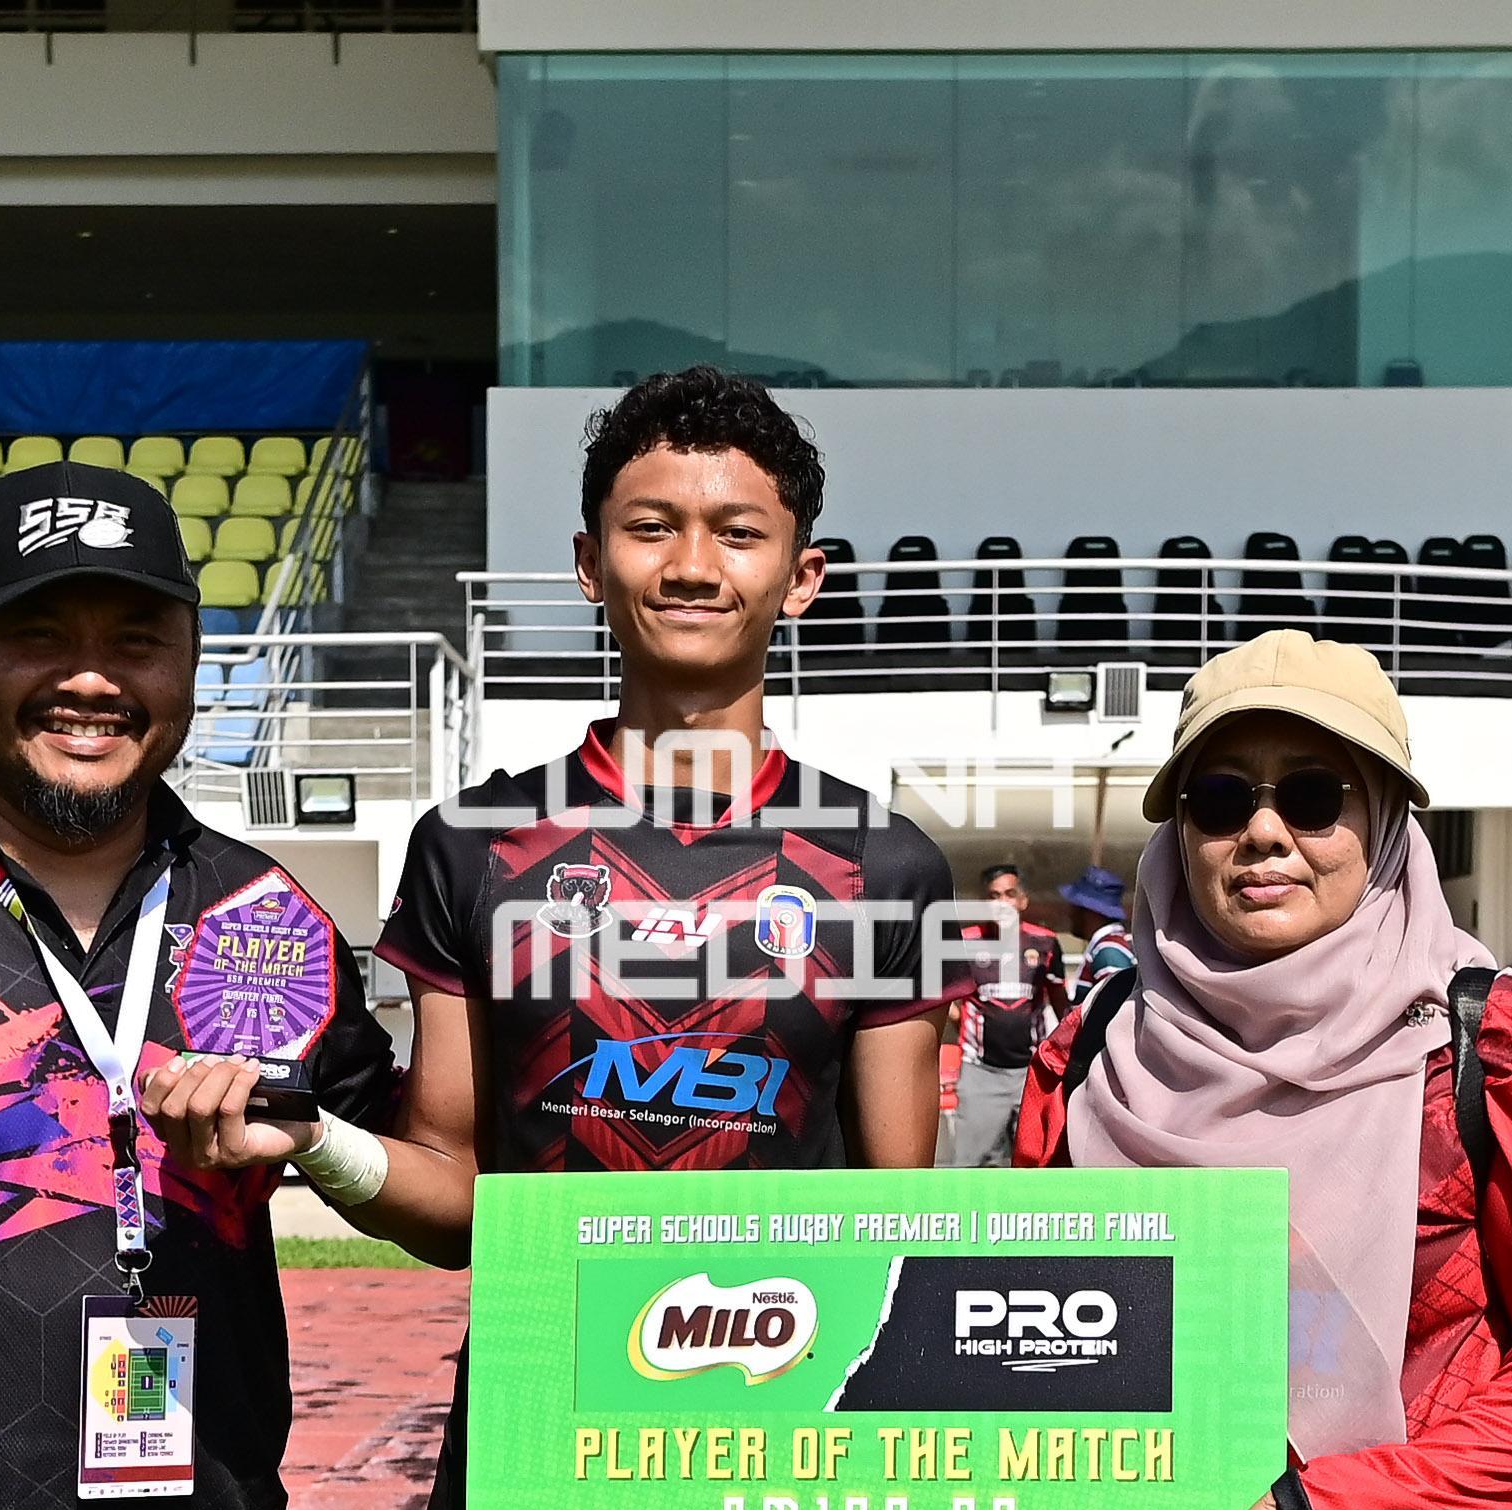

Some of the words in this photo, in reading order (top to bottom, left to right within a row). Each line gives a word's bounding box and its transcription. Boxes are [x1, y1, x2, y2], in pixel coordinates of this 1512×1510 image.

[217, 935, 307, 962] PLAYER
[214, 958, 229, 970] OF
[235, 960, 257, 974] THE
[262, 962, 304, 977] MATCH
[247, 976, 286, 987] PREMIER
[223, 989, 259, 1001] QUARTER
[262, 993, 285, 1004] FINAL
[582, 1039, 790, 1116] MBI
[541, 1101, 588, 1117] Menteri
[591, 1104, 626, 1120] Besar
[629, 1108, 686, 1126] Selangor
[689, 1115, 777, 1136] (Incorporation)
[577, 1215, 652, 1244] SUPER
[660, 1214, 760, 1244] SCHOOLS
[769, 1213, 844, 1246] RUGBY
[854, 1213, 961, 1242] PREMIER
[987, 1212, 1095, 1245] QUARTER
[1105, 1212, 1175, 1241] FINAL
[657, 1305, 795, 1349] MILO
[955, 1290, 1118, 1337] PRO
[955, 1340, 1012, 1356] HIGH
[1019, 1340, 1117, 1356] PROTEIN
[574, 1427, 767, 1482] PLAYER
[792, 1427, 853, 1482] OF
[877, 1427, 973, 1482] THE
[998, 1427, 1175, 1483] MATCH
